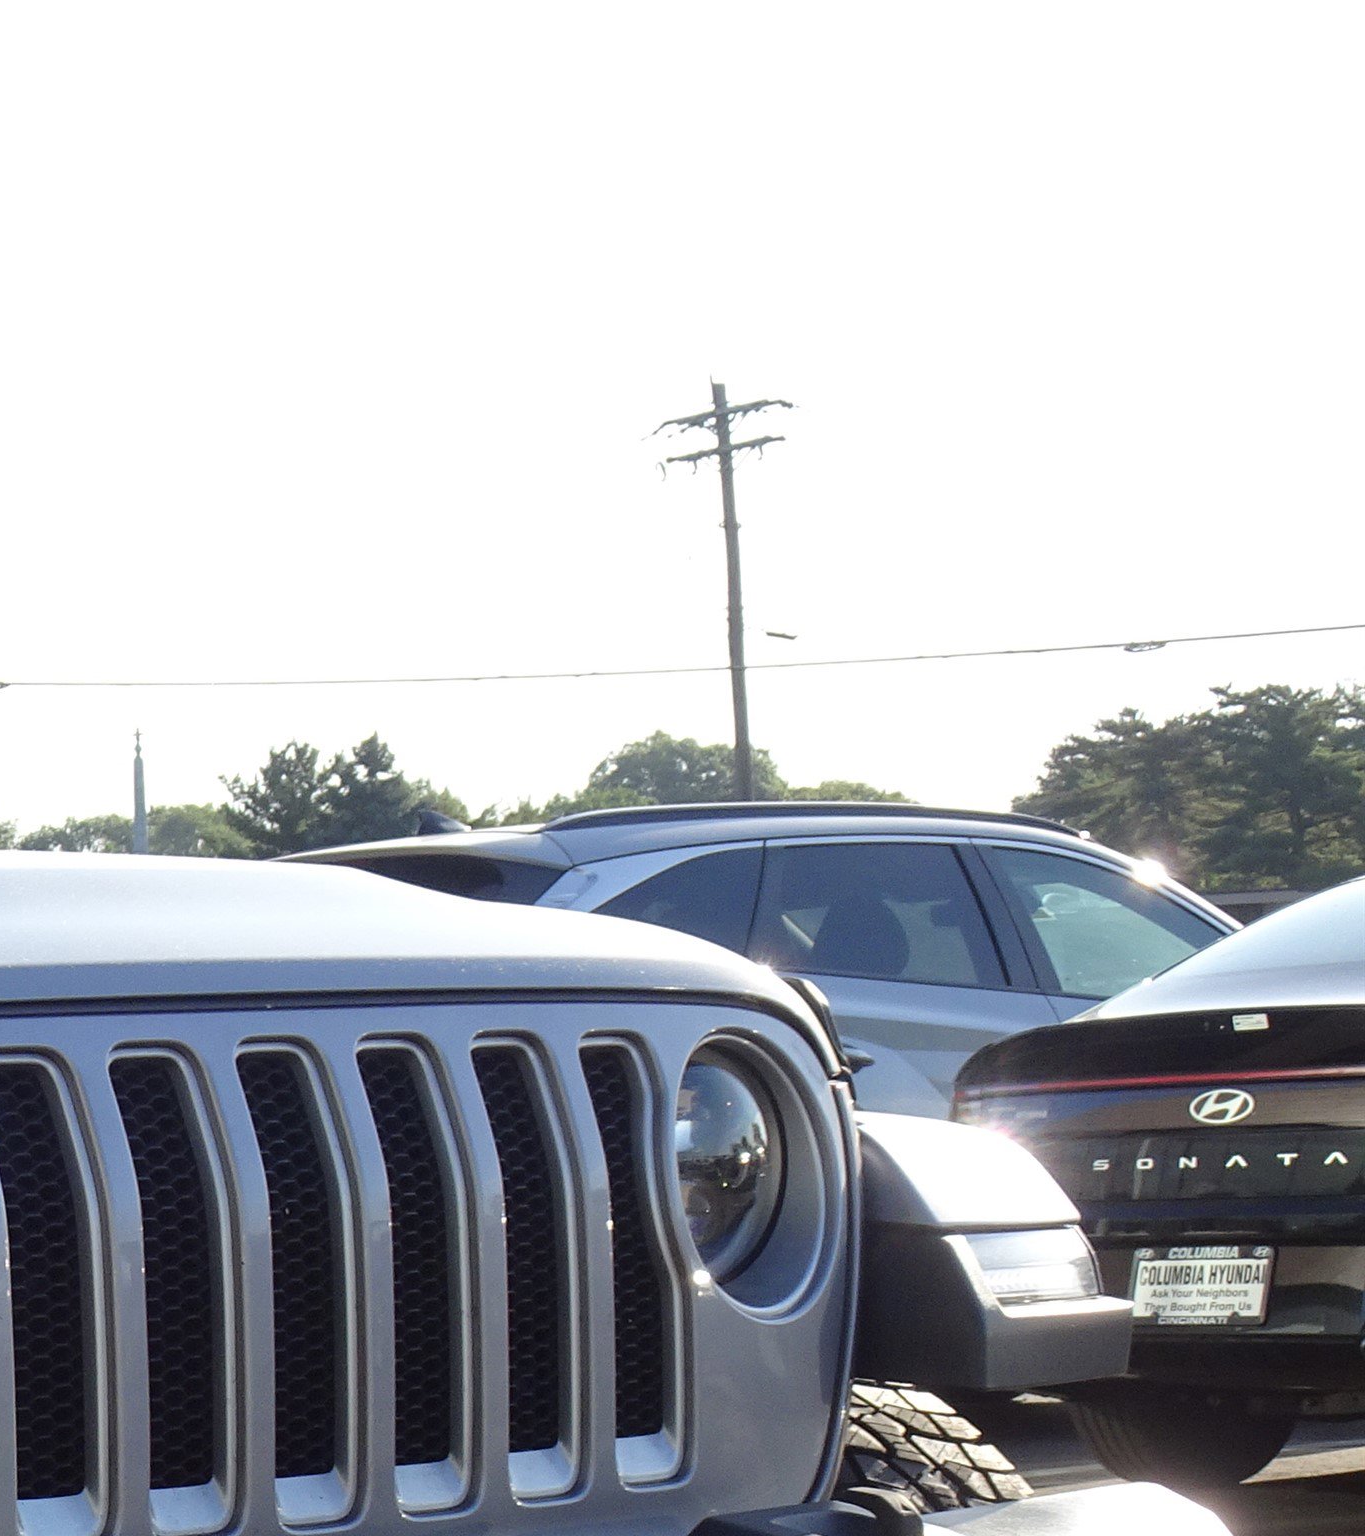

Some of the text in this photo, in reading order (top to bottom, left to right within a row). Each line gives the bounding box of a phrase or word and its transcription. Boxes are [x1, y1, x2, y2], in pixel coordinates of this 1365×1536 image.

[1092, 1150, 1349, 1171] SONATA
[1168, 1246, 1239, 1259] COLUMBIA
[1139, 1263, 1267, 1286] COLUMBIA HYUNDAI
[1151, 1287, 1249, 1300] Ask Your Neighbors
[1144, 1300, 1253, 1314] They Bought From Us
[1157, 1315, 1229, 1325] CINCINNATI
